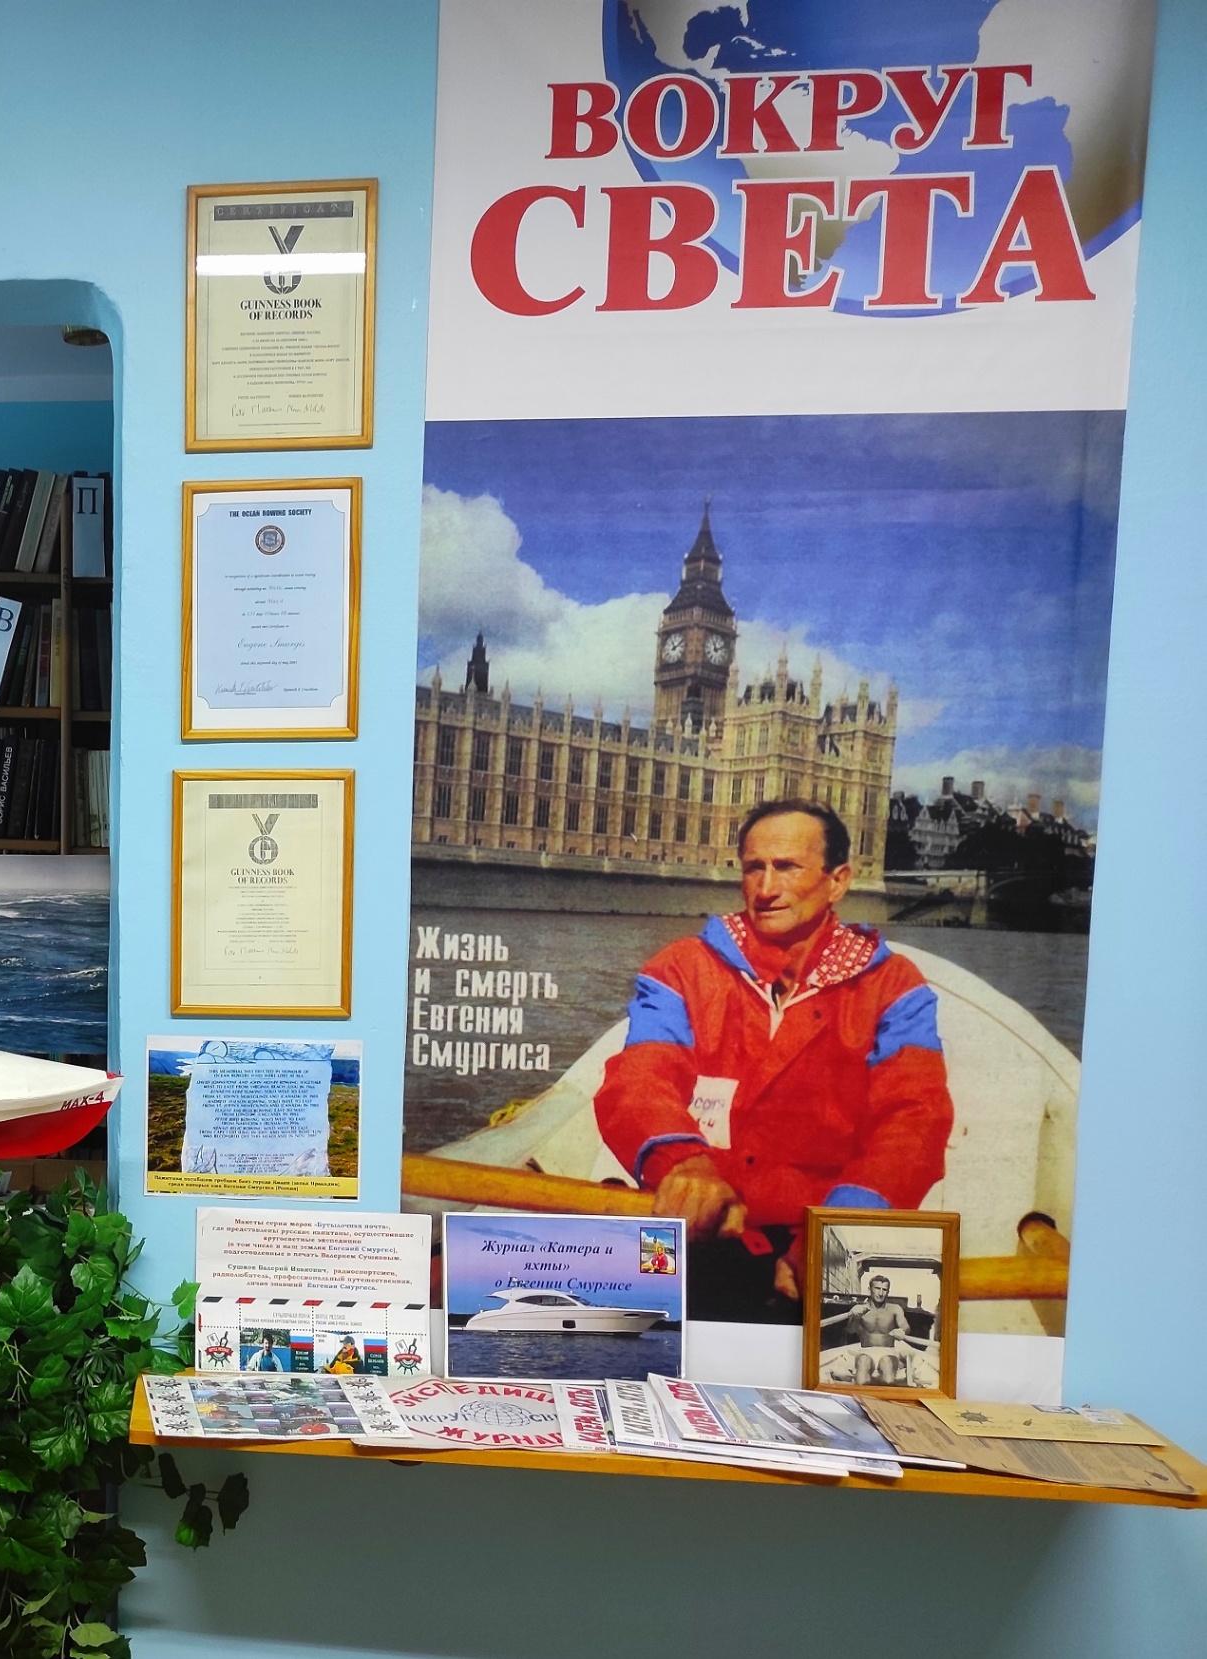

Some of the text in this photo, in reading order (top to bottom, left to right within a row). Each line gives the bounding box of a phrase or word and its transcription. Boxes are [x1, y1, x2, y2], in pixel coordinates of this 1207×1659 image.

[544, 64, 1034, 160] ВОКРУГ
[470, 168, 1097, 317] СВЕТА
[240, 298, 322, 311] GUINNESS BOOK
[249, 309, 313, 321] OF RECORDS
[229, 508, 313, 518] THE OCEAN ROWING SOCIETY
[230, 867, 295, 877] GUINNESS BOOK
[237, 876, 288, 885] OF RECORDS
[416, 926, 509, 961] Жизнь
[414, 968, 558, 1005] и смерть
[412, 997, 524, 1035] Евгения
[412, 1033, 550, 1076] Смургиса
[481, 1239, 614, 1256] Журнал «Катера и
[523, 1262, 570, 1272] яхты»
[494, 1276, 633, 1292] о Евгении Смургисе
